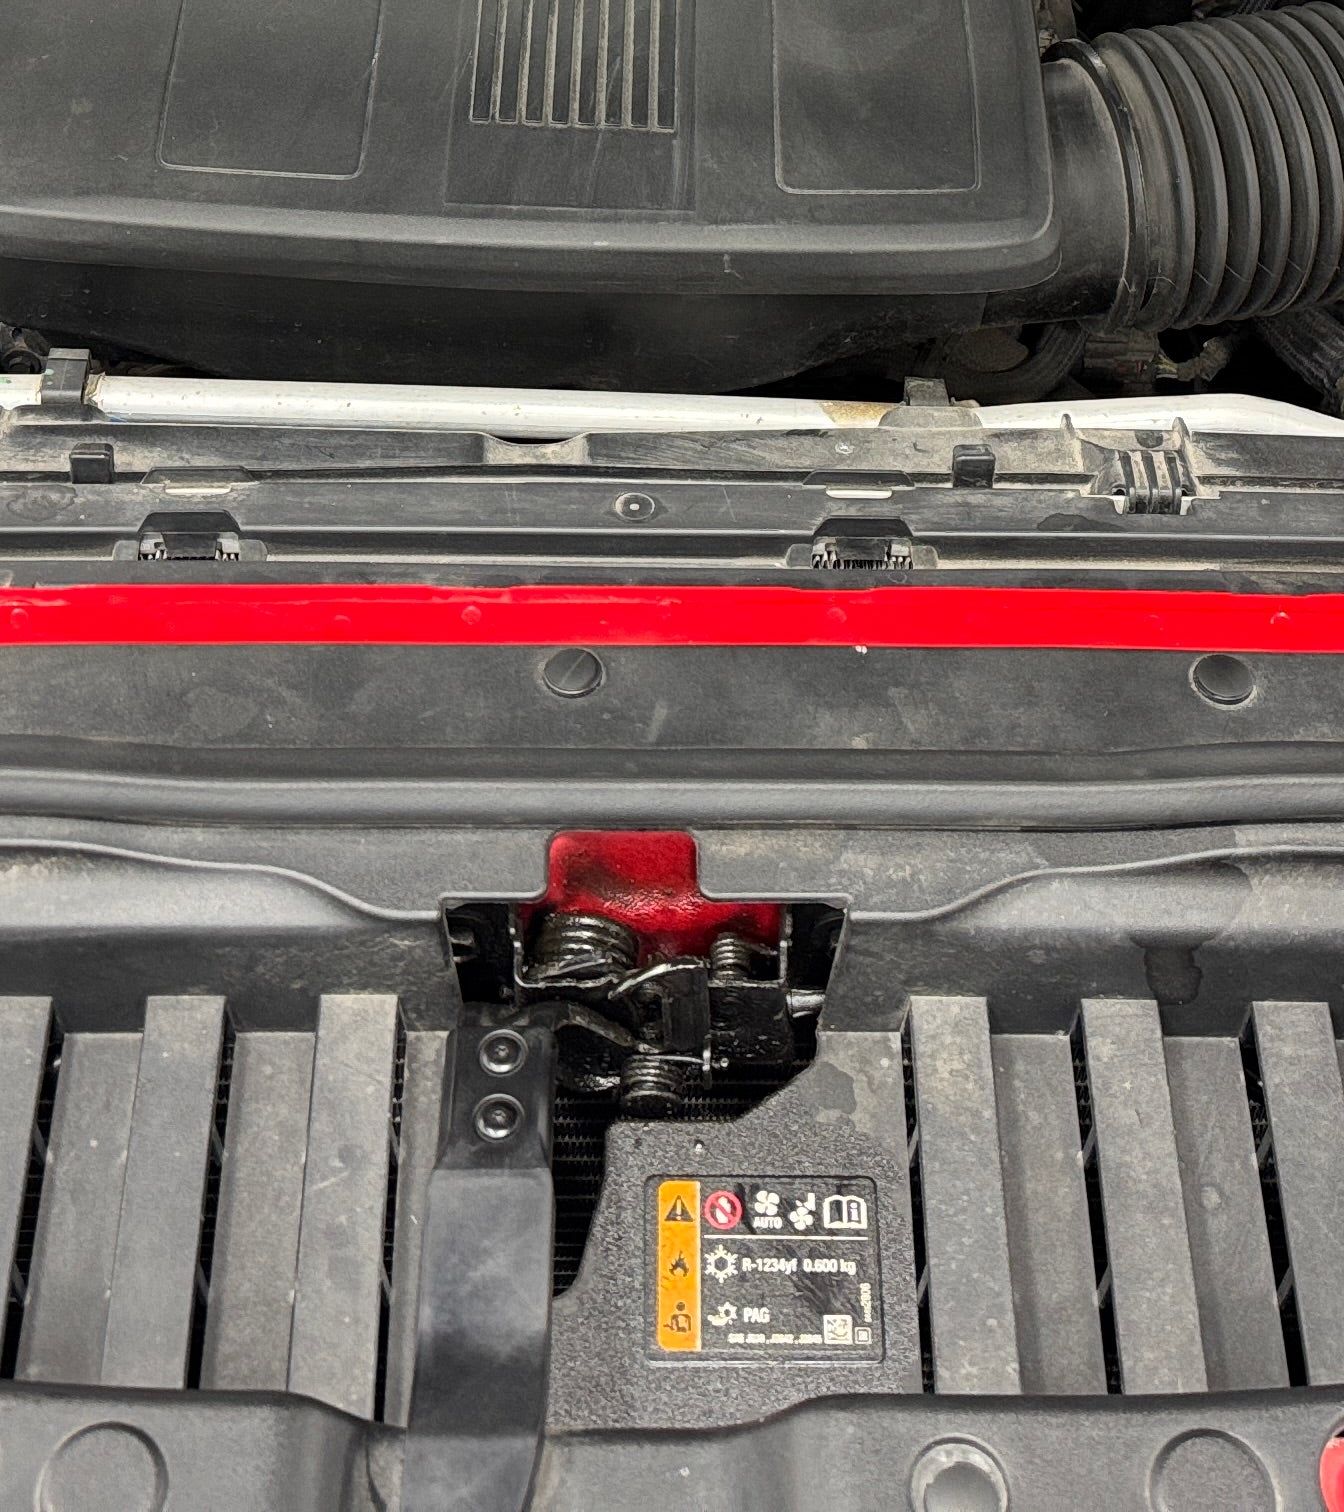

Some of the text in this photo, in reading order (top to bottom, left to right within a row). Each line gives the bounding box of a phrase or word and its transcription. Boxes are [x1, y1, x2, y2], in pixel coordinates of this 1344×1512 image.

[753, 1217, 782, 1229] AUTO
[742, 1258, 857, 1275] R-1234yf 0.600 kg
[743, 1308, 771, 1323] PAG
